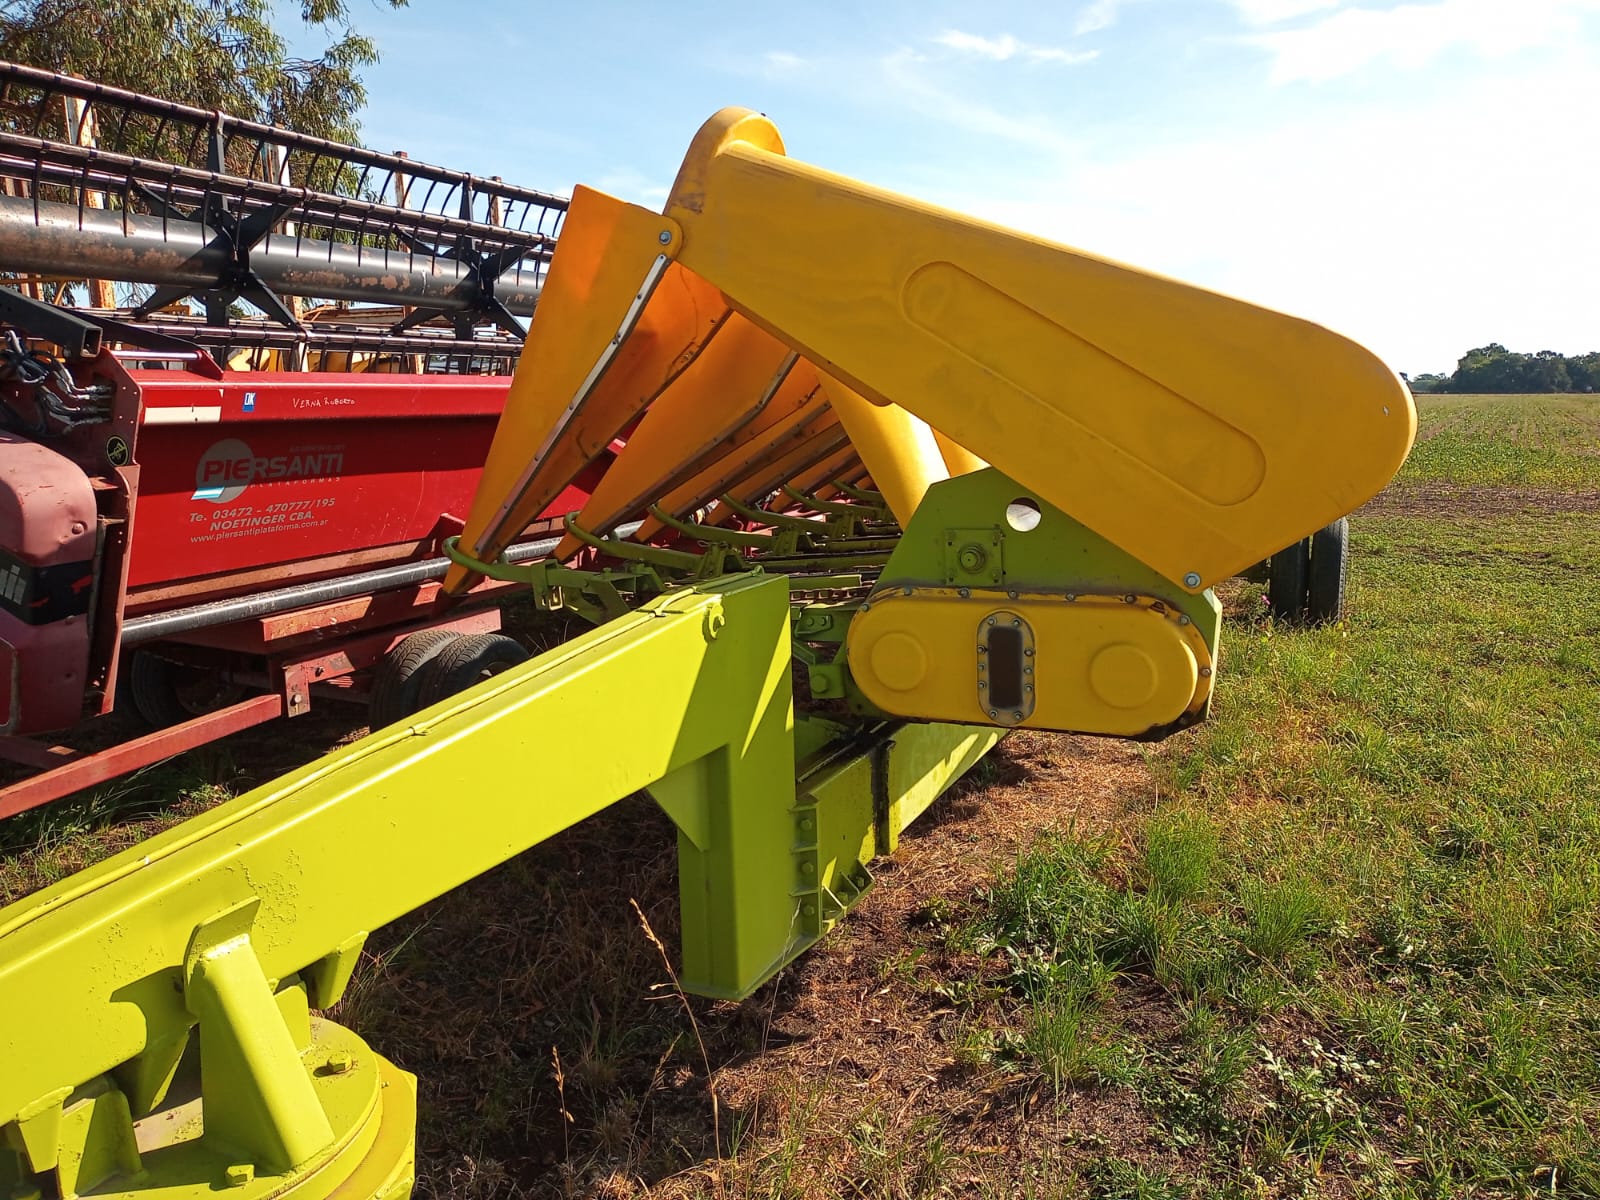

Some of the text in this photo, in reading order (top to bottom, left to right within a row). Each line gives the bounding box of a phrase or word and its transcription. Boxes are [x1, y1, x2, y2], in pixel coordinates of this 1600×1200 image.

[203, 453, 344, 482] PIERSANTI
[190, 512, 207, 522] Te.
[212, 507, 253, 520] 03472
[265, 498, 336, 513] 470777/195
[210, 511, 315, 531] NOETINGER CBA.
[190, 519, 329, 543] www.piersantiplataforma.com.ar
